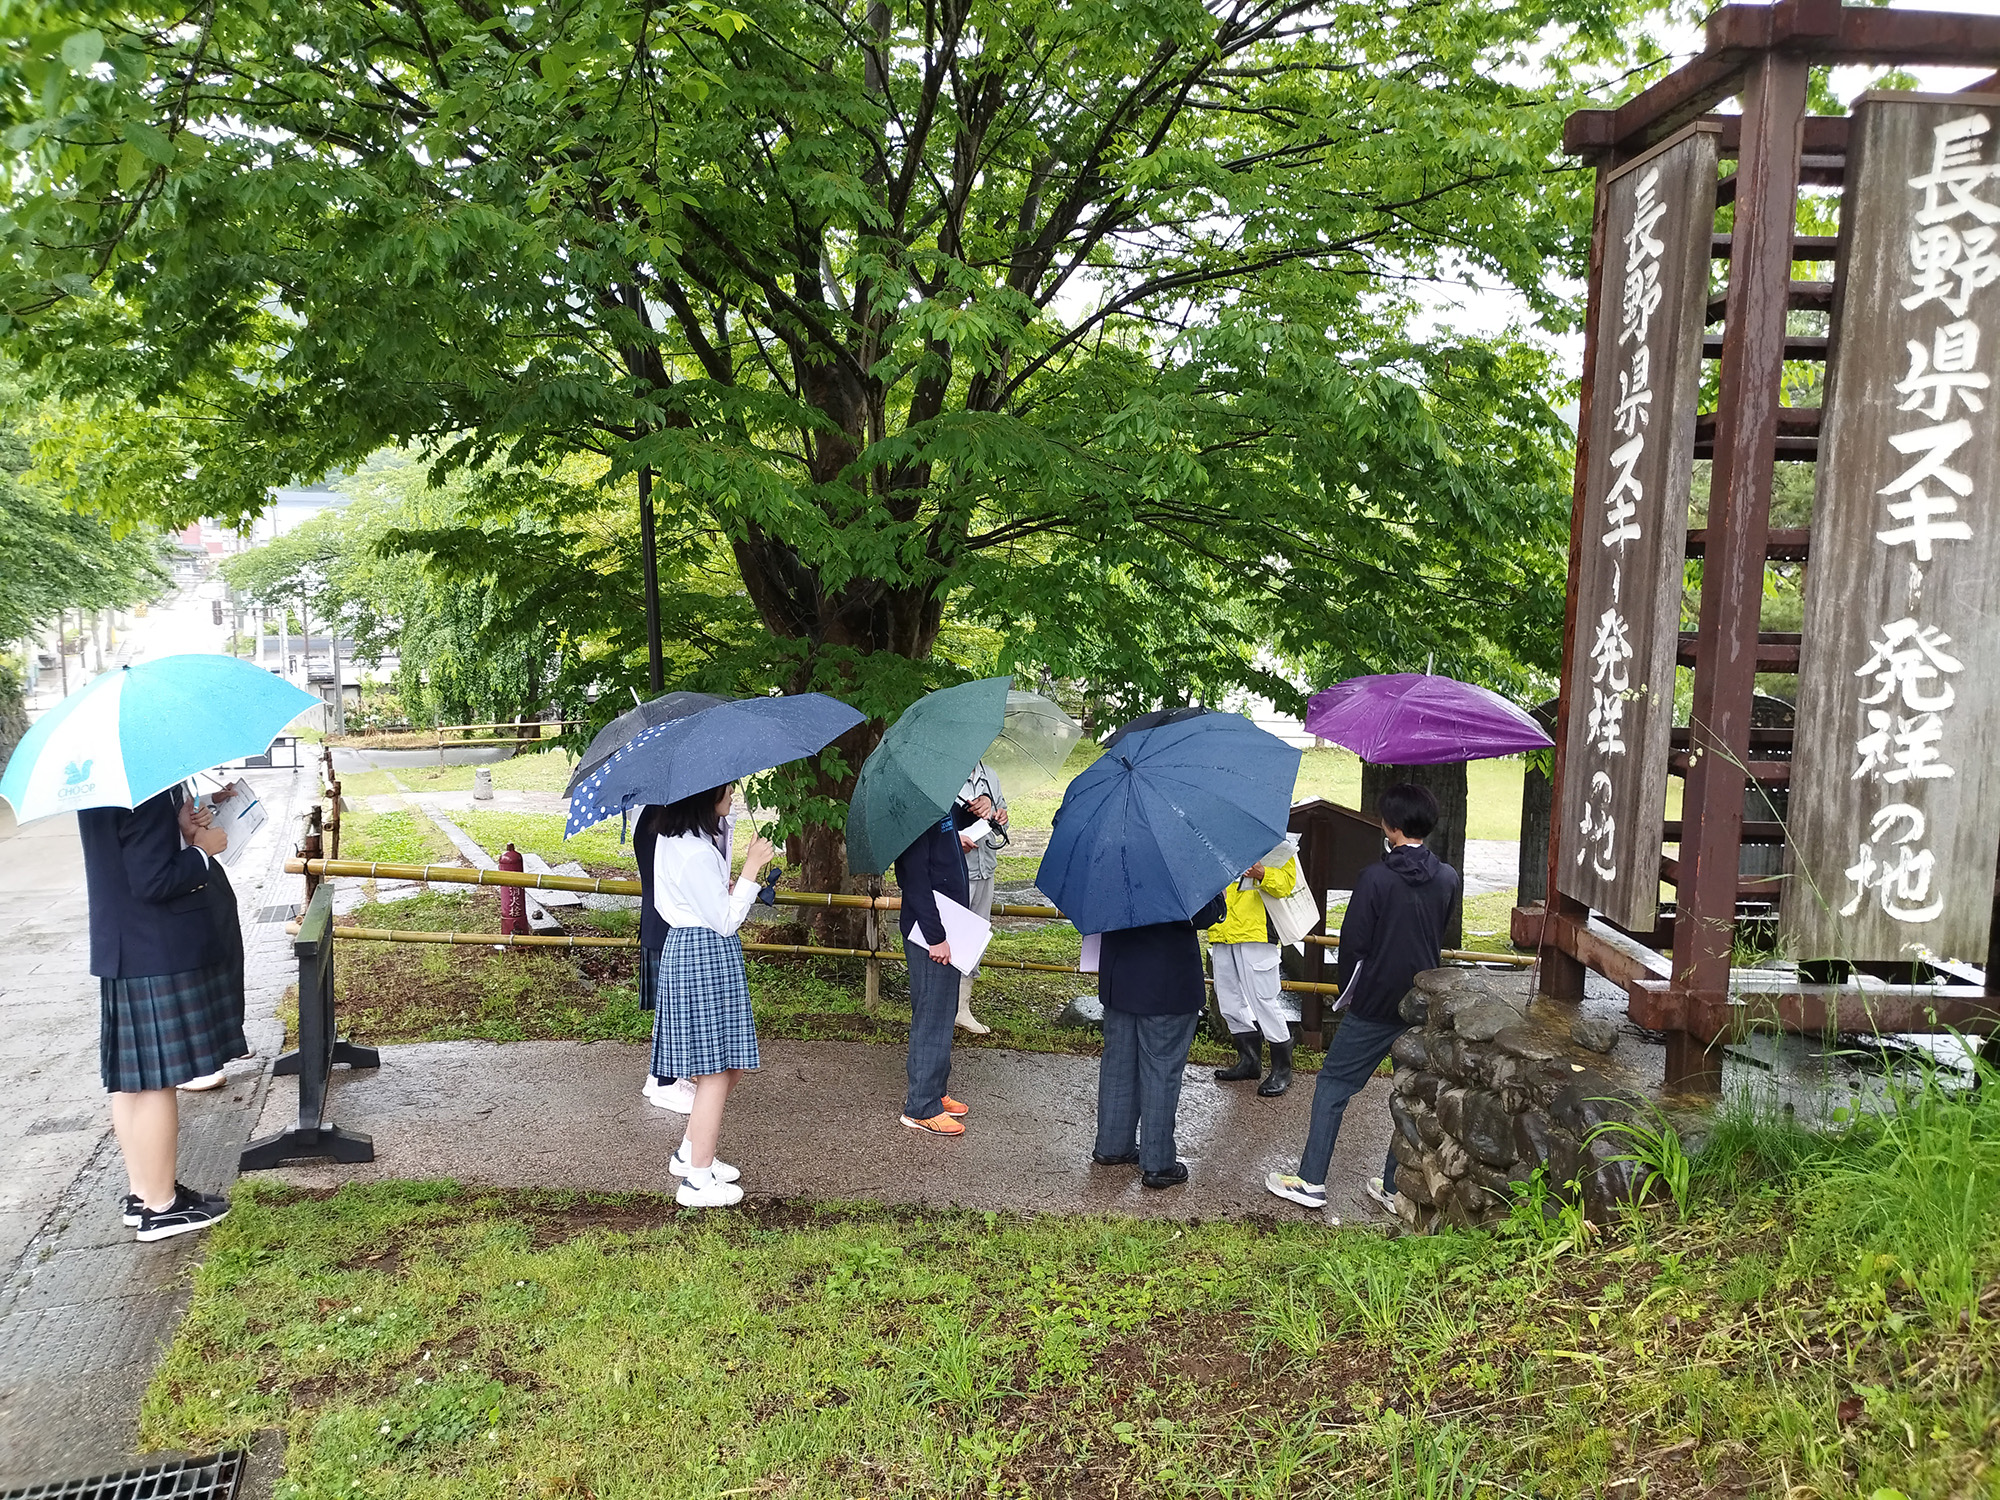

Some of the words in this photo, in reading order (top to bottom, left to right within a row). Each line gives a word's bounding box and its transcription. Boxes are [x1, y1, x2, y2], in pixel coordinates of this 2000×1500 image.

[57, 783, 96, 798] CHOOP
[1577, 167, 1667, 881] 長野県スキー発祥の地
[1839, 113, 2000, 923] 長野県スキー発祥の地
